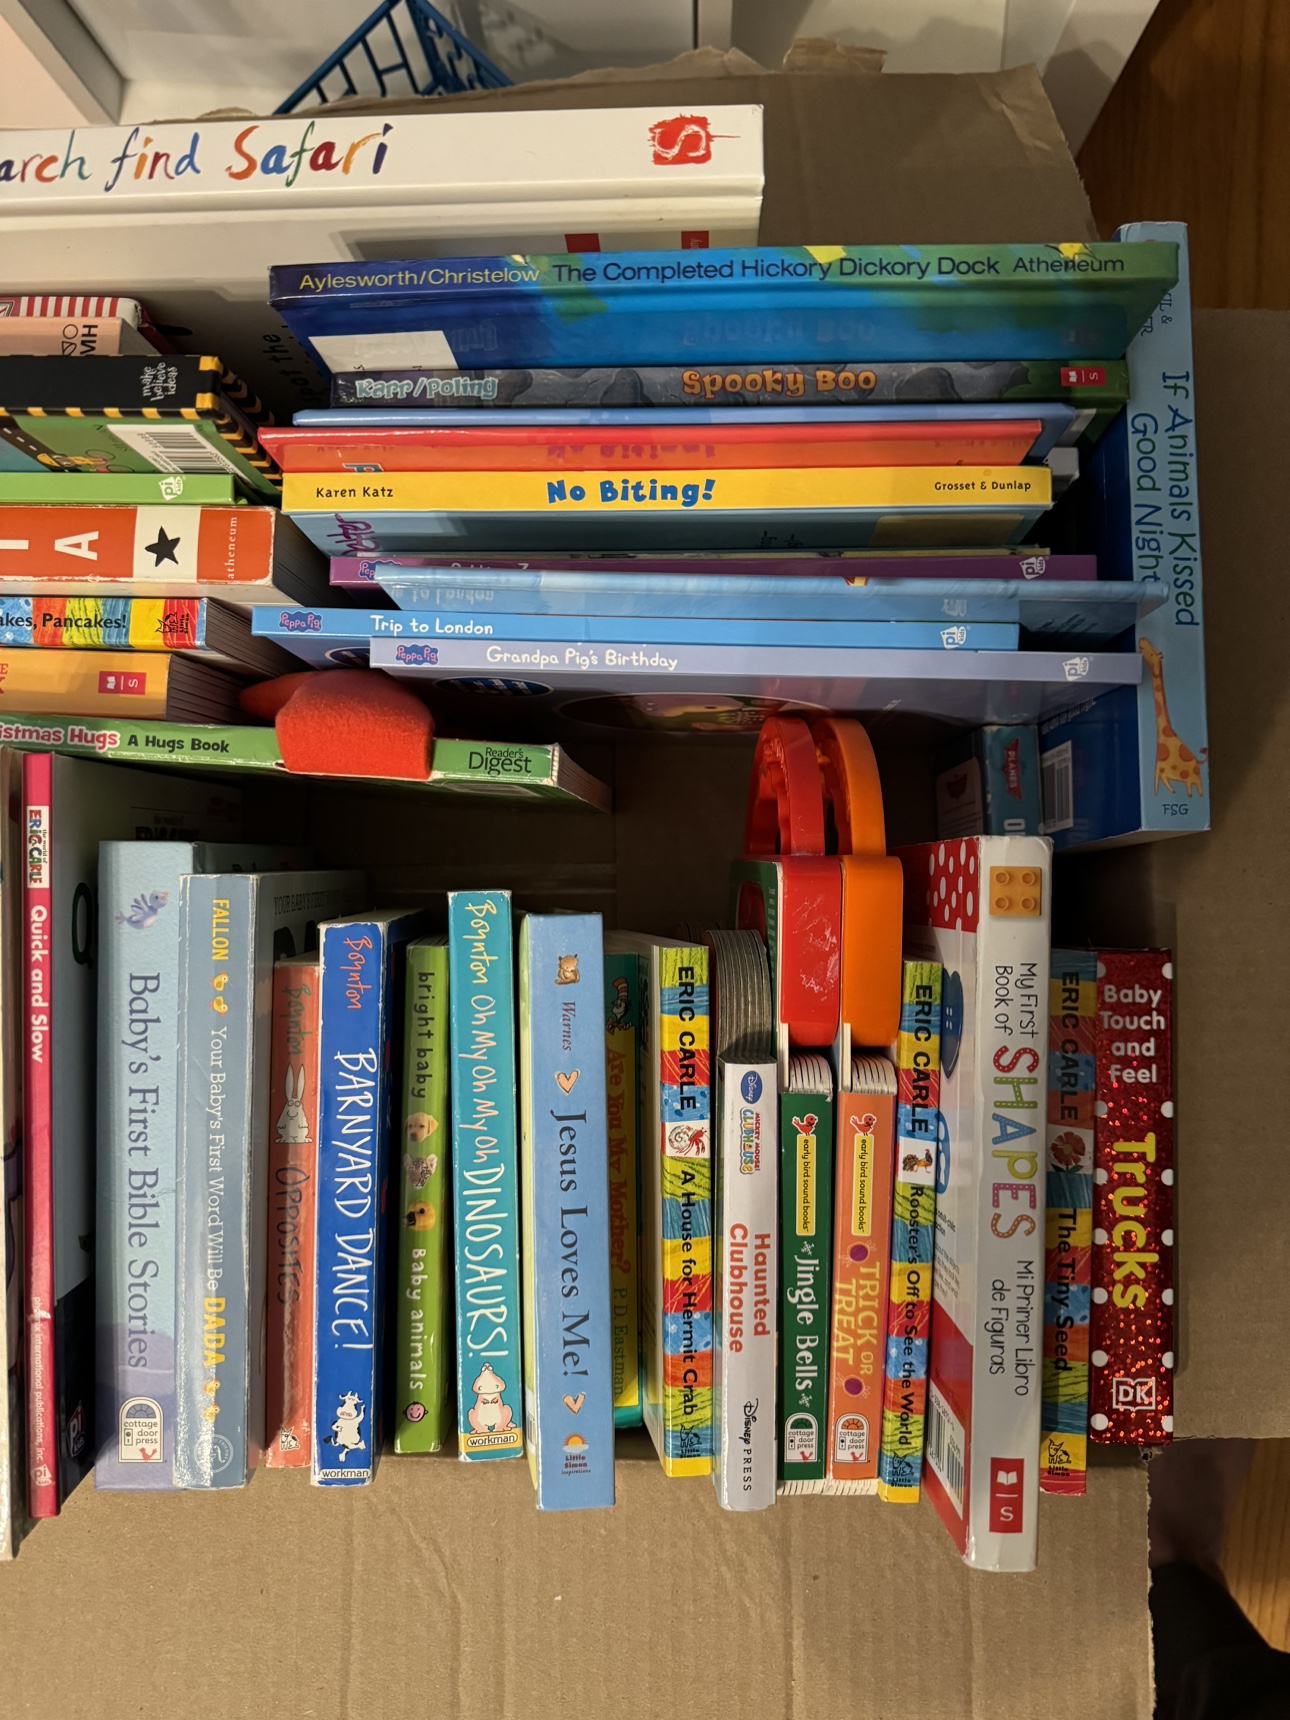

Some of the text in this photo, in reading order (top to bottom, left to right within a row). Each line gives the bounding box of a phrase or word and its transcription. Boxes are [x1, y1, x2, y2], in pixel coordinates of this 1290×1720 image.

[104, 127, 201, 192] find
[225, 121, 393, 187] Safari
[300, 266, 539, 293] Aylesworth/Christelow
[554, 256, 1000, 285] The Completed Hickory Dickory Dock
[1013, 255, 1125, 274] Atheneum
[140, 365, 157, 397] make
[150, 361, 166, 402] believe
[164, 366, 179, 396] ideas
[356, 376, 499, 401] Karr/Poling
[682, 370, 877, 398] Spooky Boo
[316, 486, 393, 498] Karen Katz
[547, 479, 716, 508] No Biting!
[934, 480, 976, 492] Grosset
[991, 480, 1031, 493] Dunlap
[1131, 412, 1164, 582] Good Night
[1162, 371, 1200, 626] If Animals Kissed
[224, 516, 238, 580] atheneum
[42, 613, 127, 629] Pancakes!
[280, 612, 321, 632] Peppa Pig
[370, 614, 493, 635] Trip to London
[486, 646, 678, 671] Grandpa Pig's Birthday
[69, 727, 119, 750] Hugs
[127, 734, 229, 753] A Hugs Book
[468, 750, 532, 776] Digest
[485, 746, 523, 760] Reader's
[1006, 751, 1017, 789] PLANES
[1162, 804, 1189, 816] FSG
[29, 810, 43, 884] ERIC CARLE
[212, 899, 230, 961] FALLON
[463, 900, 499, 984] Boynton
[30, 905, 48, 1063] Quick and Slow
[340, 935, 373, 1010] Boynton
[995, 965, 1013, 1036] Book of
[1014, 962, 1039, 1039] My First
[1103, 984, 1162, 1008] Baby
[280, 983, 312, 1056] Boynton
[411, 971, 435, 1099] bright baby
[561, 1001, 576, 1052] Warnes
[678, 966, 697, 1110] ERIC CARLE
[1100, 1011, 1165, 1030] Touch
[1111, 1037, 1155, 1057] and
[912, 985, 933, 1133] ERIC CARLE
[1109, 1064, 1157, 1083] Feel
[122, 973, 161, 1369] Baby's First Bible Stories
[458, 994, 509, 1358] Oh My Oh My Oh DINOSAURS!
[607, 1047, 631, 1274] Are You My Mother?
[801, 1139, 809, 1163] early
[204, 1026, 227, 1367] Your Baby's First Word Will Be DADA
[332, 1047, 377, 1350] BARNYARD DANCE!
[1112, 1132, 1160, 1308] Trucks
[275, 1167, 309, 1305] OPPOSITES
[550, 1109, 591, 1377] Jesus Loves Me!
[681, 1170, 699, 1416] A House for Hermit Crab
[729, 1224, 748, 1353] Clubhouse
[754, 1233, 771, 1336] Haunted
[900, 1186, 925, 1445] Rooster's Off to See the World
[1054, 1208, 1077, 1371] The Tiny Seed
[406, 1249, 428, 1391] Baby animals
[787, 1255, 820, 1390] Jingle Bells
[834, 1279, 857, 1365] TREAT
[857, 1261, 881, 1375] TRICK OR
[984, 1279, 1011, 1375] de Figuras
[1015, 1260, 1037, 1396] Mi Primer Libro
[33, 1335, 44, 1389] international
[613, 1327, 629, 1396] Eastman
[124, 1420, 158, 1429] cottage
[1118, 1385, 1149, 1403] DK
[135, 1437, 158, 1446] press
[137, 1429, 158, 1437] door
[739, 1398, 759, 1491] Disney PRESS
[788, 1429, 815, 1437] cottage
[322, 1469, 369, 1478] workman
